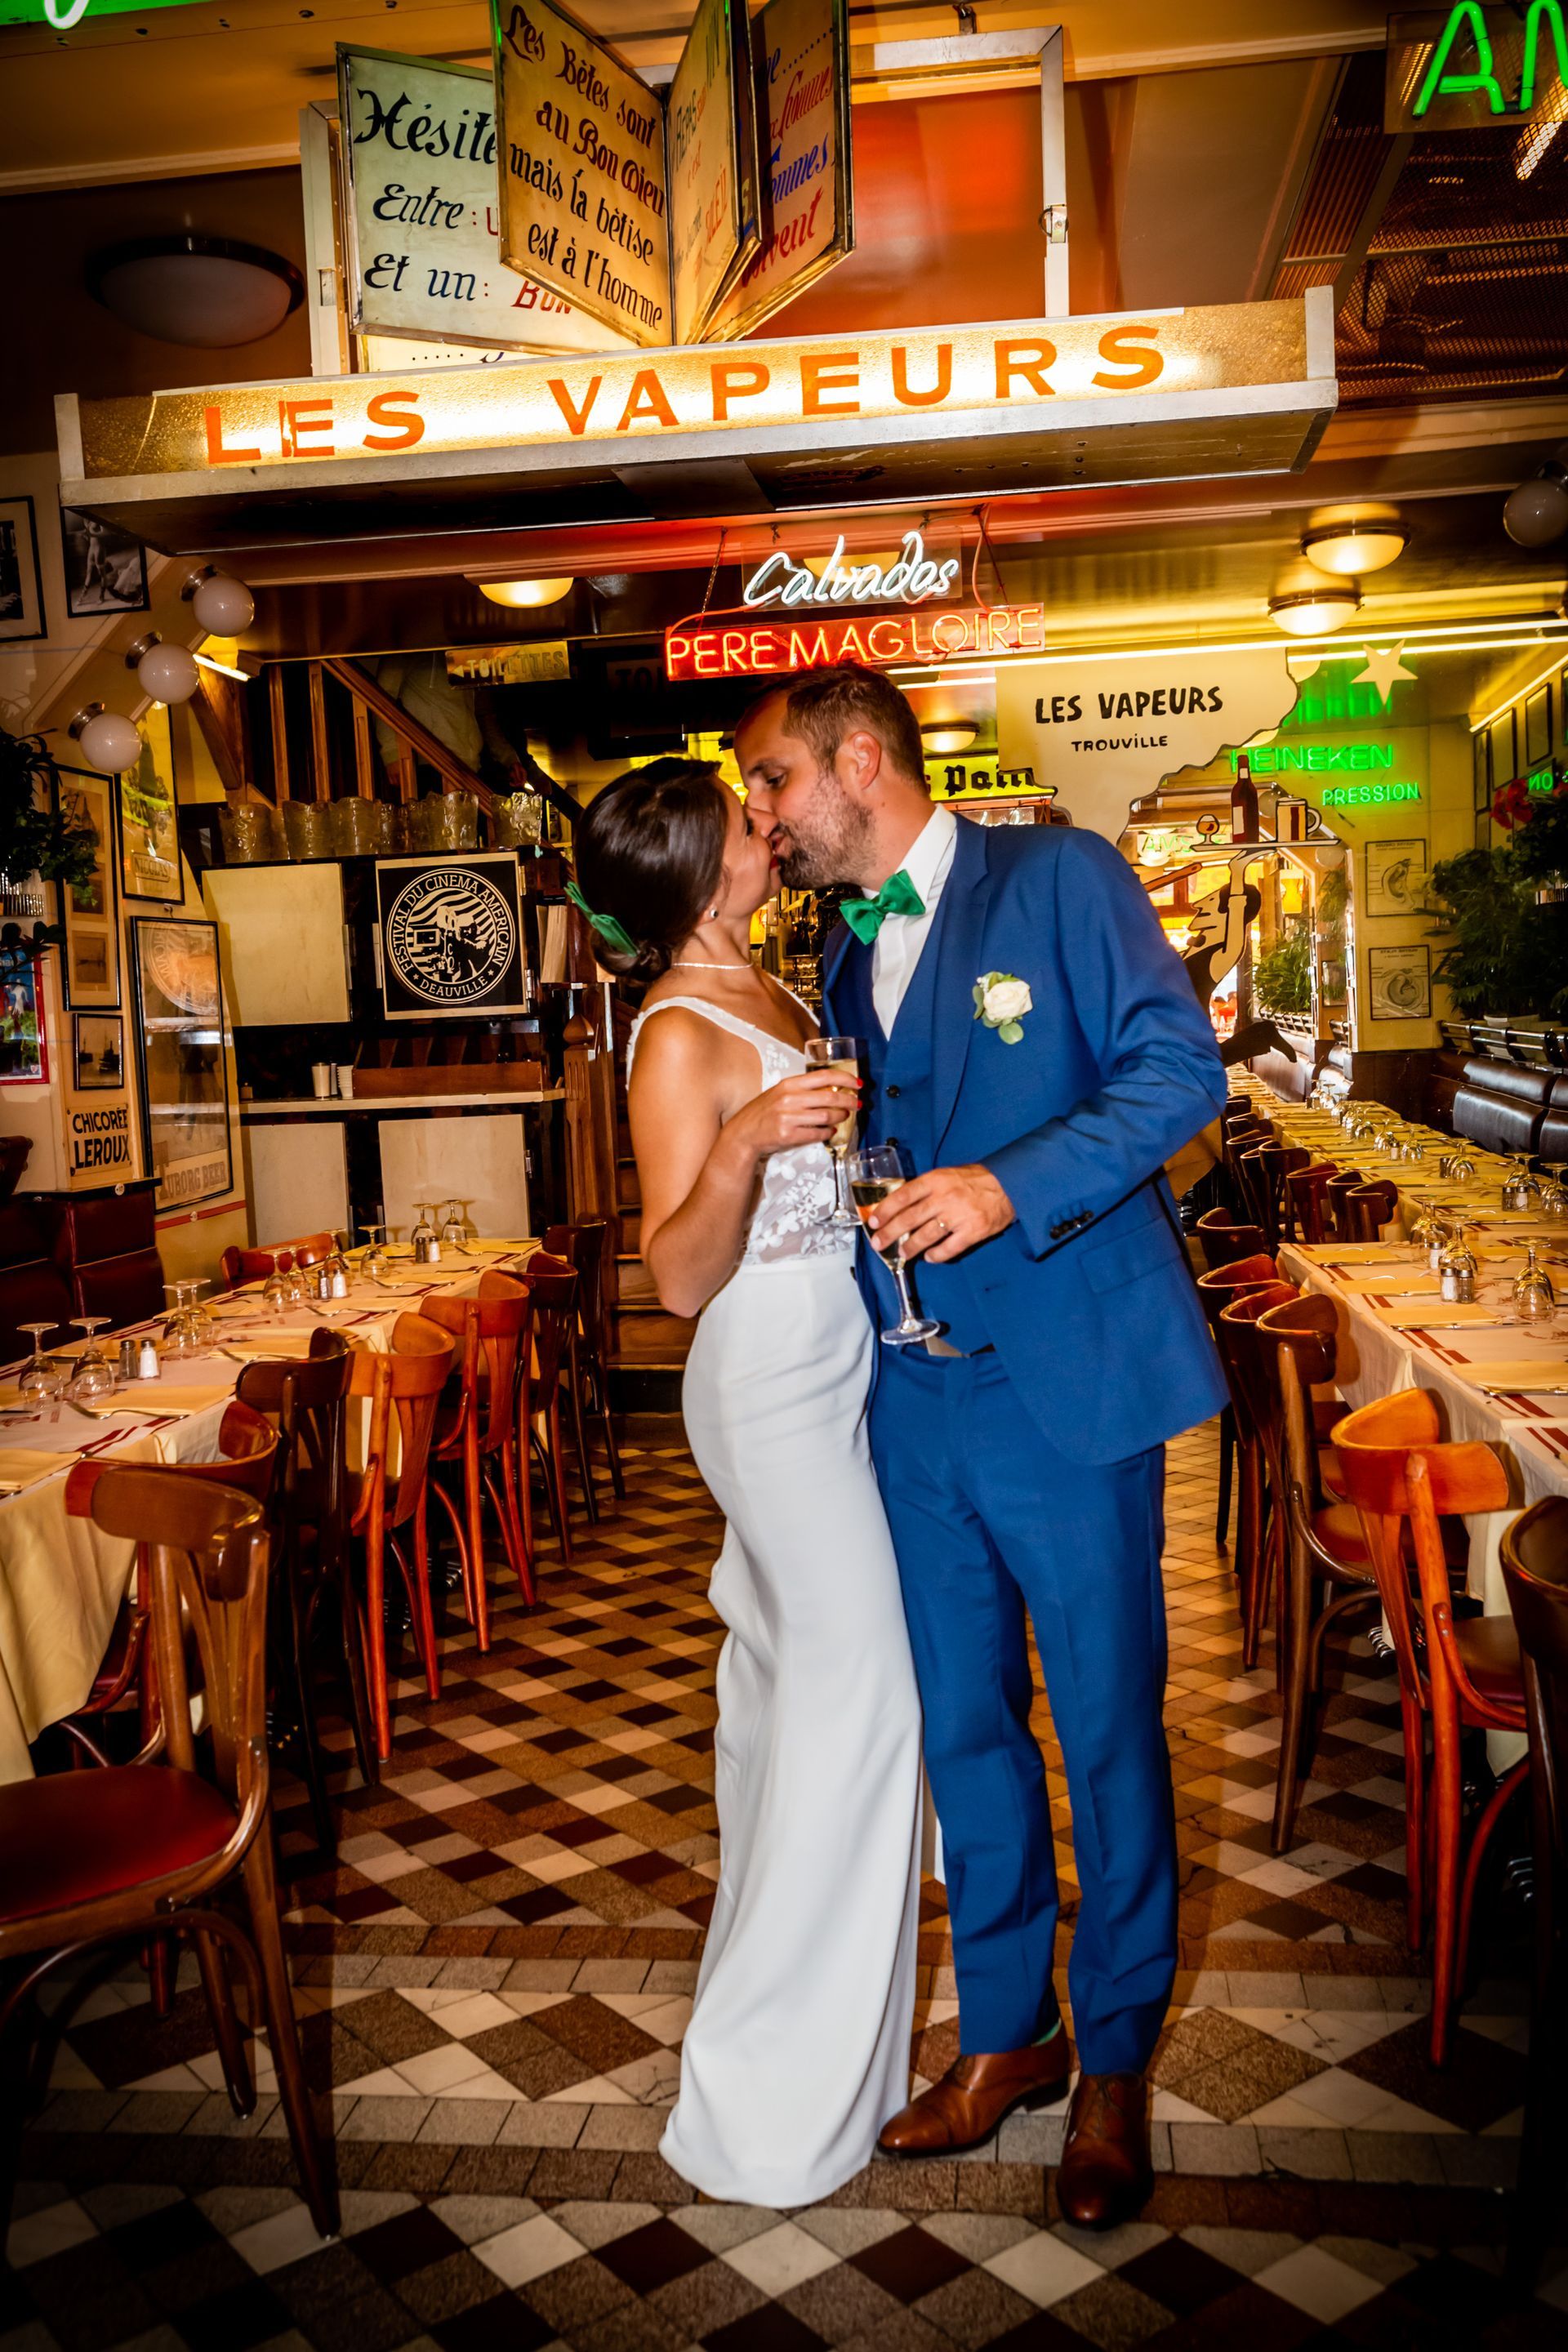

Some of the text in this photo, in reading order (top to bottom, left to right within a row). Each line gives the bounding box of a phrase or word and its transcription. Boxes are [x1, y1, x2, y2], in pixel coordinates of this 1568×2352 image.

[503, 5, 546, 63] Les
[617, 99, 656, 149] sont
[510, 144, 564, 203] mais
[536, 100, 665, 218] au Bon Dieu
[364, 253, 410, 292] Et
[528, 224, 559, 265] est
[562, 237, 577, 278] à
[584, 249, 662, 331] l'homme
[204, 326, 1165, 465] LES VAPEURS
[743, 530, 960, 606] Calvados
[666, 608, 1043, 677] PERE MAGLOIRE
[470, 650, 565, 679] TOILETTES
[1036, 686, 1223, 724] LES VAPEURS
[1230, 744, 1393, 773] HEINEKEN
[1322, 782, 1420, 806] PRESSION
[134, 857, 168, 877] NICOLAS
[393, 874, 510, 973] FESTIVAL DU CINEMA AMERICAIN
[419, 976, 488, 996] DEAUVILLE
[73, 1107, 128, 1134] CHICORÉE
[74, 1134, 131, 1169] LEROUX
[202, 1161, 227, 1190] BEER
